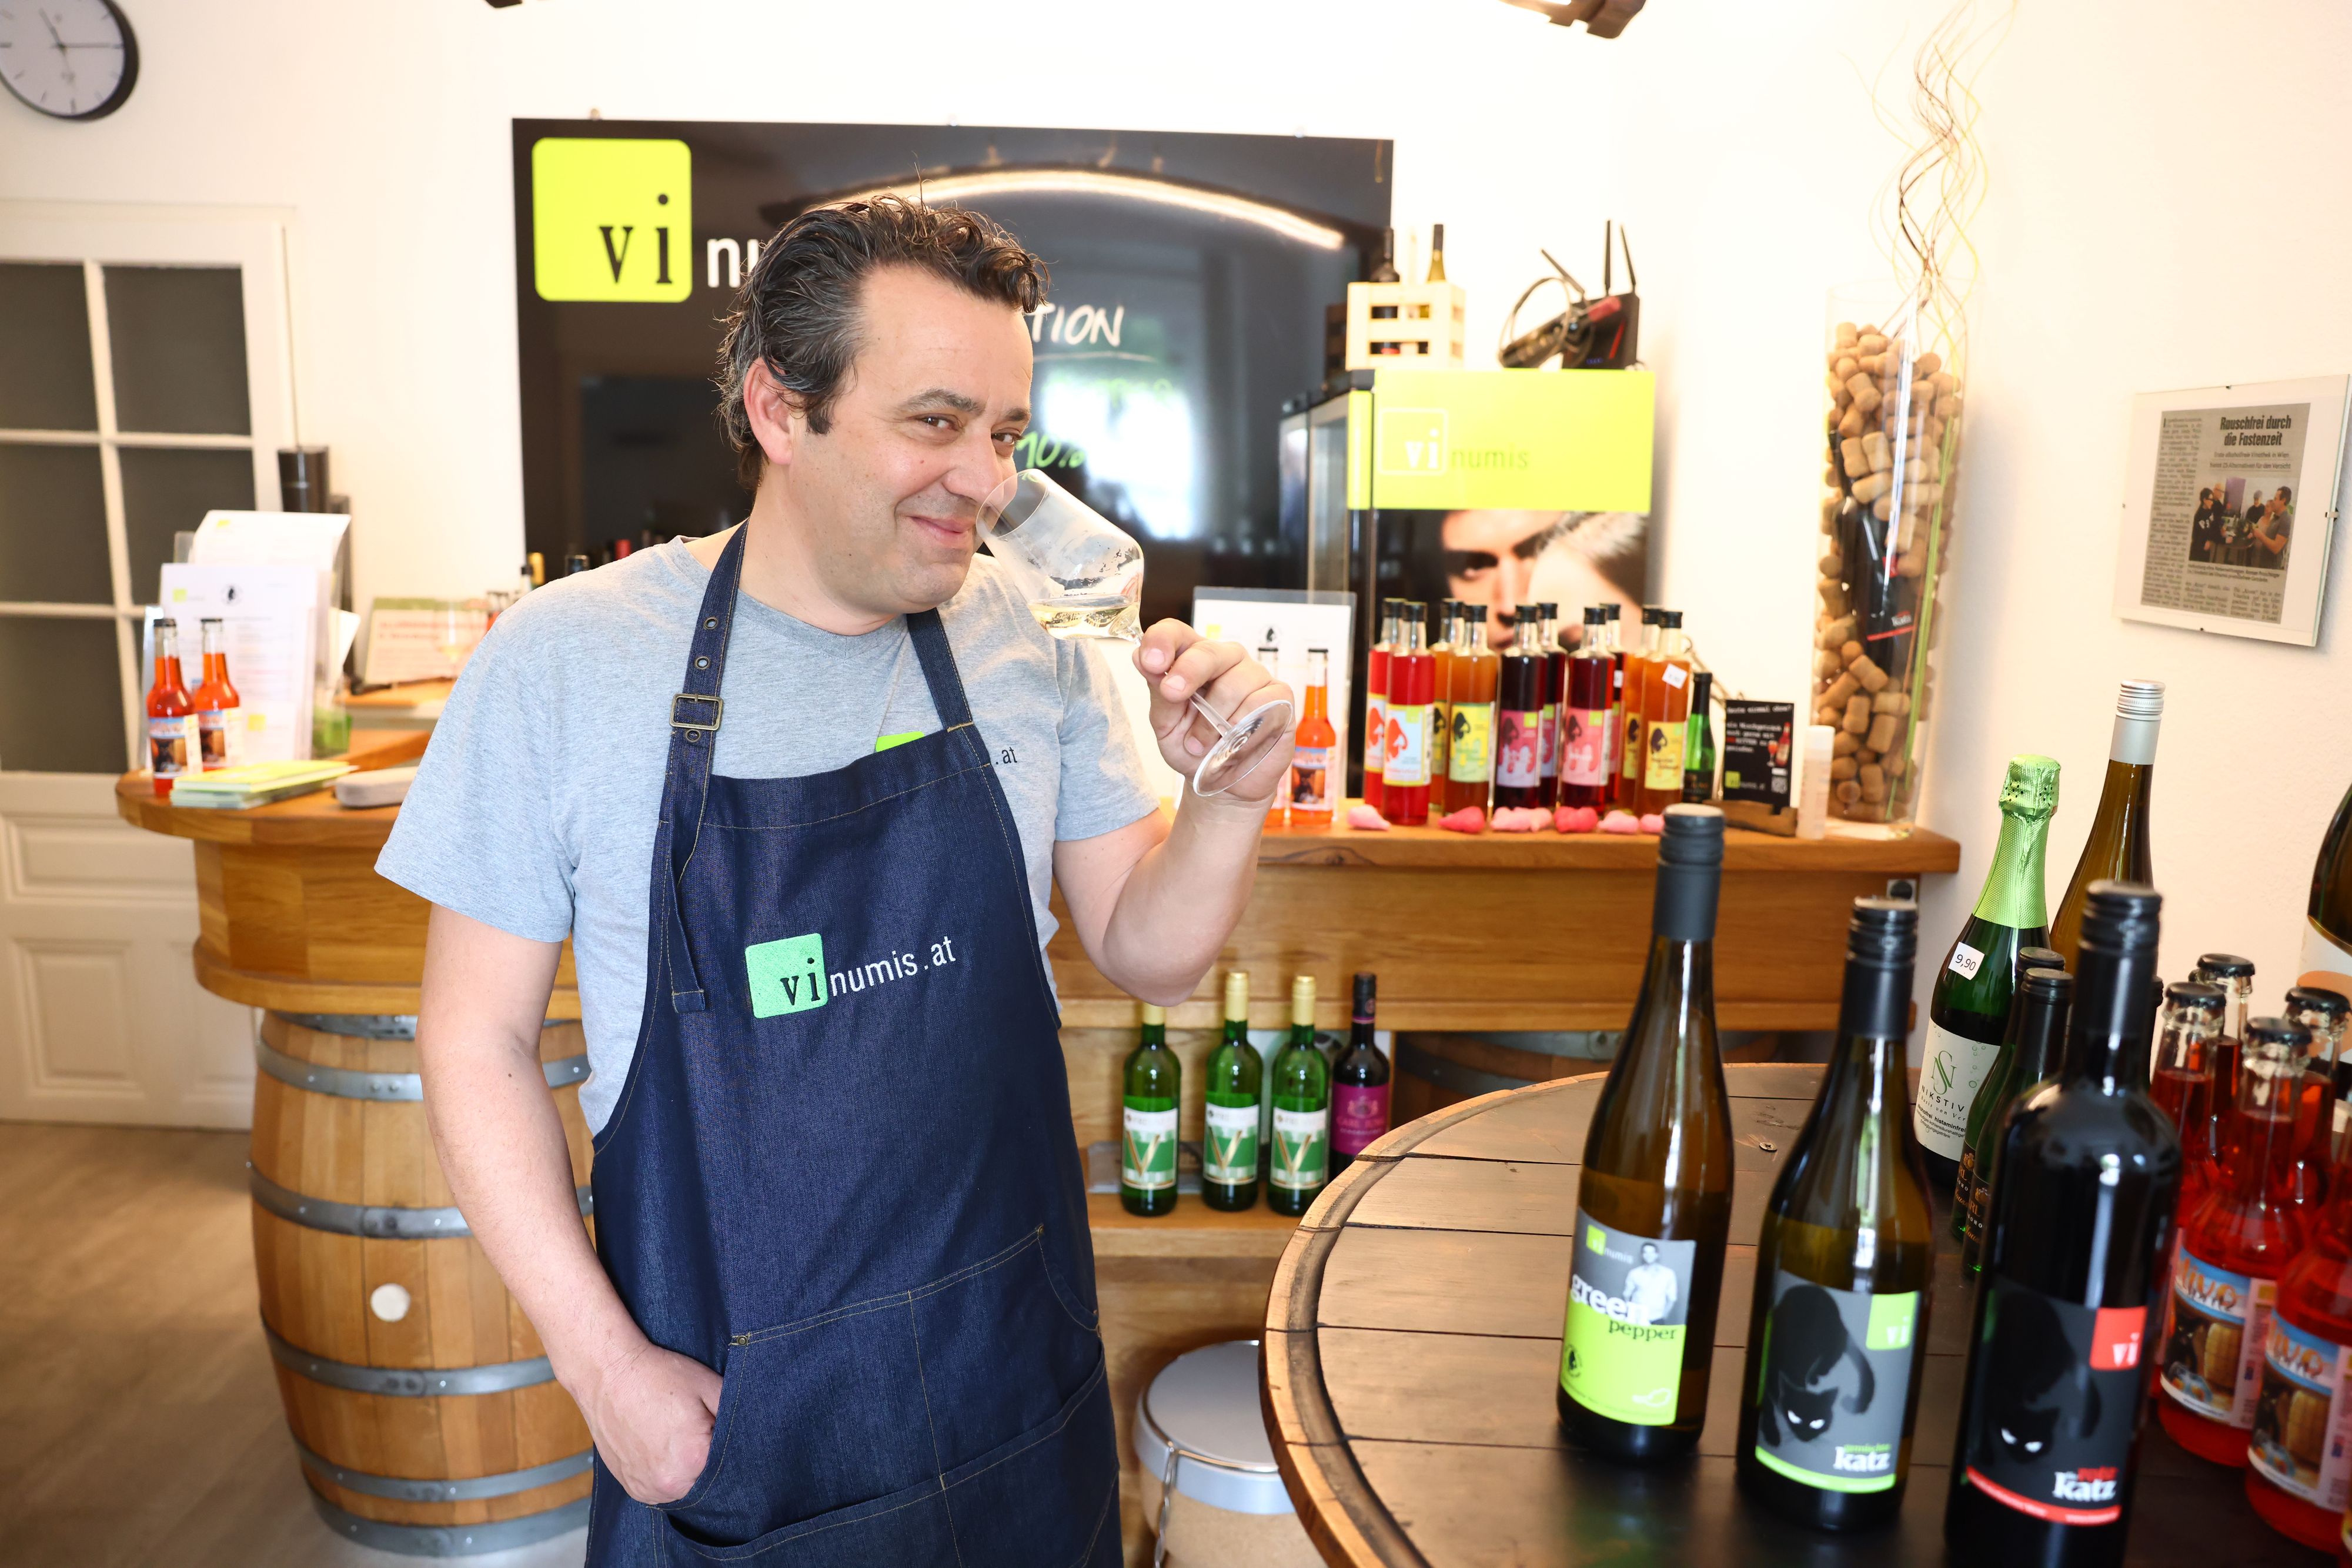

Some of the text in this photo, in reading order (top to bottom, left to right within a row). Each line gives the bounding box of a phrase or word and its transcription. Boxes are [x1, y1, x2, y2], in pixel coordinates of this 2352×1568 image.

[598, 193, 672, 284] vi
[2220, 414, 2291, 430] Rauschfrei durch
[1405, 428, 1529, 470] vi numis
[2224, 431, 2283, 446] die Fastenzeit
[1955, 954, 1976, 971] 9,90
[780, 957, 821, 1006] vi
[1934, 1116, 1967, 1133] histaminfrei
[1570, 1273, 1651, 1327] green
[1608, 1319, 1678, 1342] pepper
[1886, 1315, 1910, 1346] vi
[2112, 1331, 2140, 1368] vi
[1832, 1445, 1892, 1472] katz
